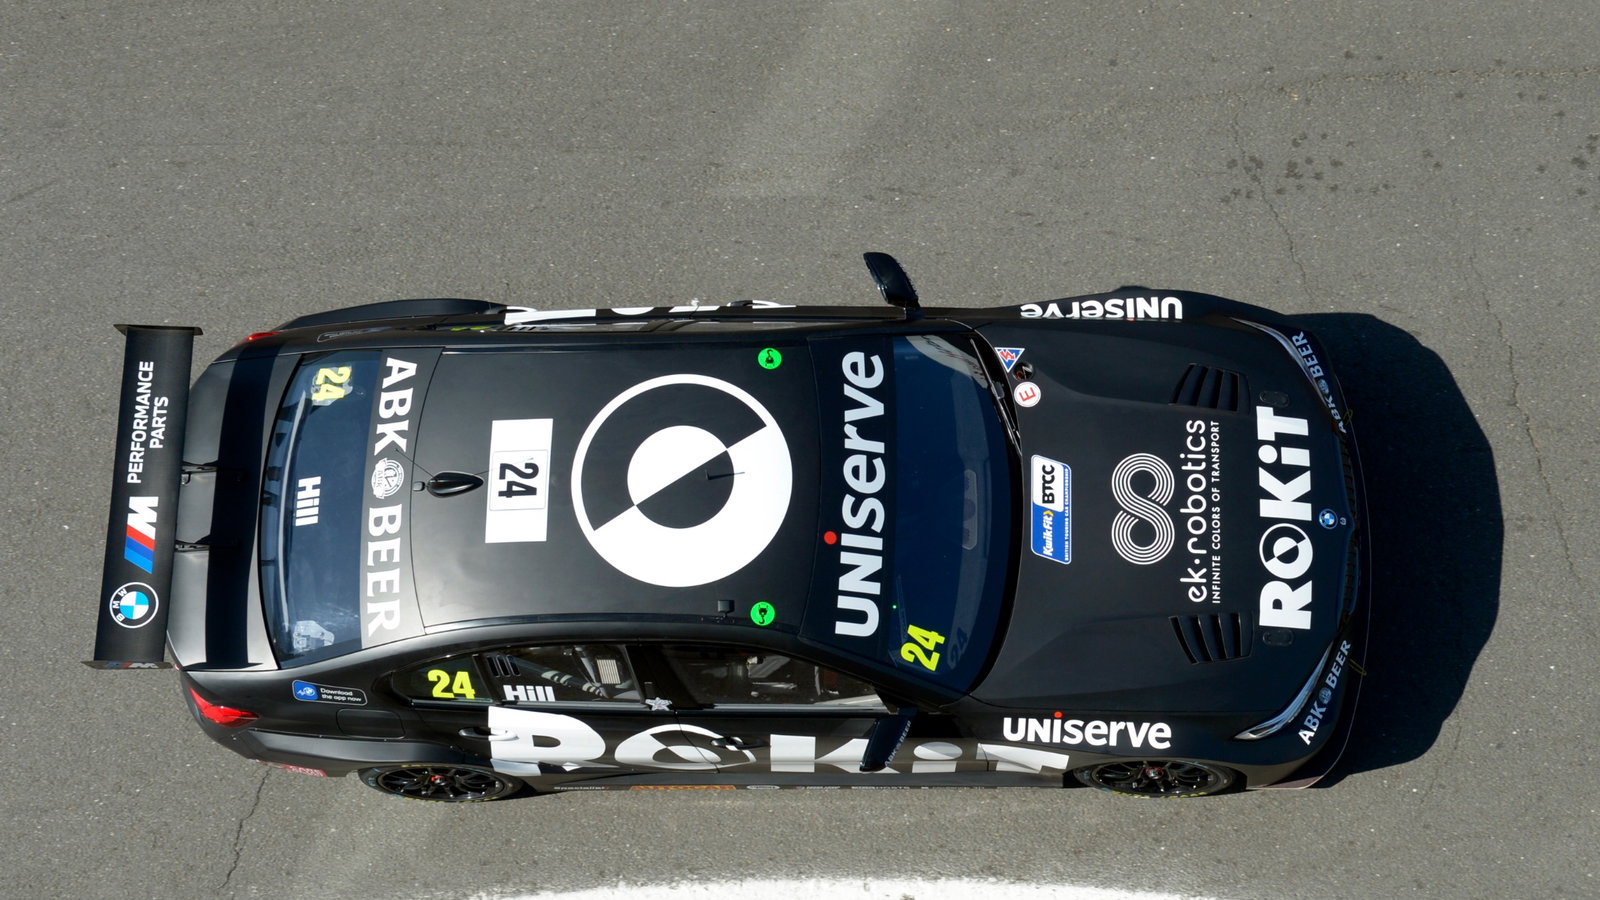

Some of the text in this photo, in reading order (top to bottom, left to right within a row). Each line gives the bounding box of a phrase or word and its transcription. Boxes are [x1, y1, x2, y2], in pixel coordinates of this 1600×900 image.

[1292, 331, 1324, 378] BEER
[312, 366, 351, 403] 24
[1019, 387, 1036, 402] E
[127, 361, 154, 483] PERFORMANCE
[150, 396, 168, 448] PARTS
[295, 476, 321, 527] Hill
[367, 357, 417, 638] ABK BEER
[498, 462, 539, 498] 24
[1042, 464, 1055, 504] BTCC
[1210, 421, 1221, 604] INFINITE COLORS OF TRANSPORT
[901, 624, 945, 671] 24
[320, 688, 353, 696] Download
[427, 669, 476, 699] 24
[503, 684, 556, 702] Hill
[1299, 640, 1351, 745] ABK BEER
